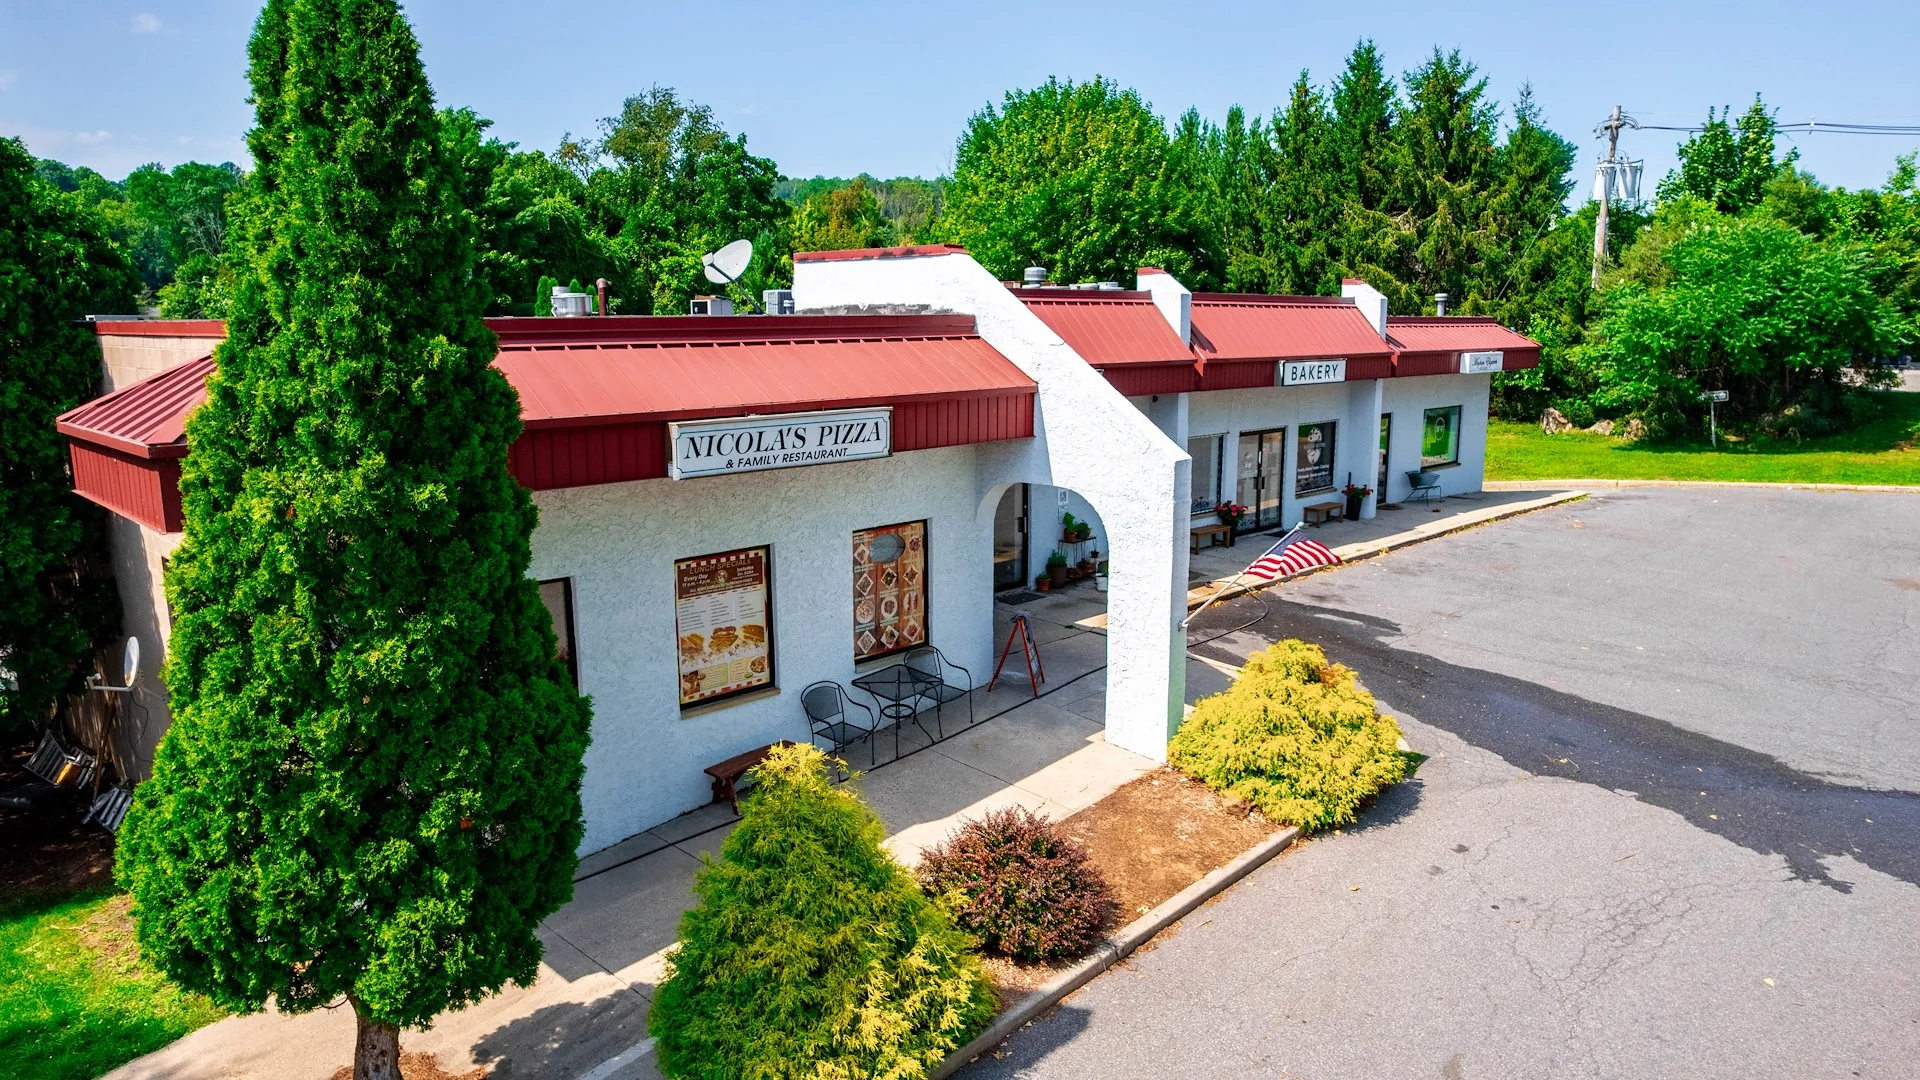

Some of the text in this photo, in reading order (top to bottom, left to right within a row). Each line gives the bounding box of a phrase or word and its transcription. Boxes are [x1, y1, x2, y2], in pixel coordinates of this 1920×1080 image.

[1291, 364, 1338, 381] BAKERY
[685, 421, 882, 459] NICOLA'S PIZZA
[725, 447, 849, 469] & FAMILY RESTAURANT
[690, 559, 751, 574] LUNCH SPECIALS
